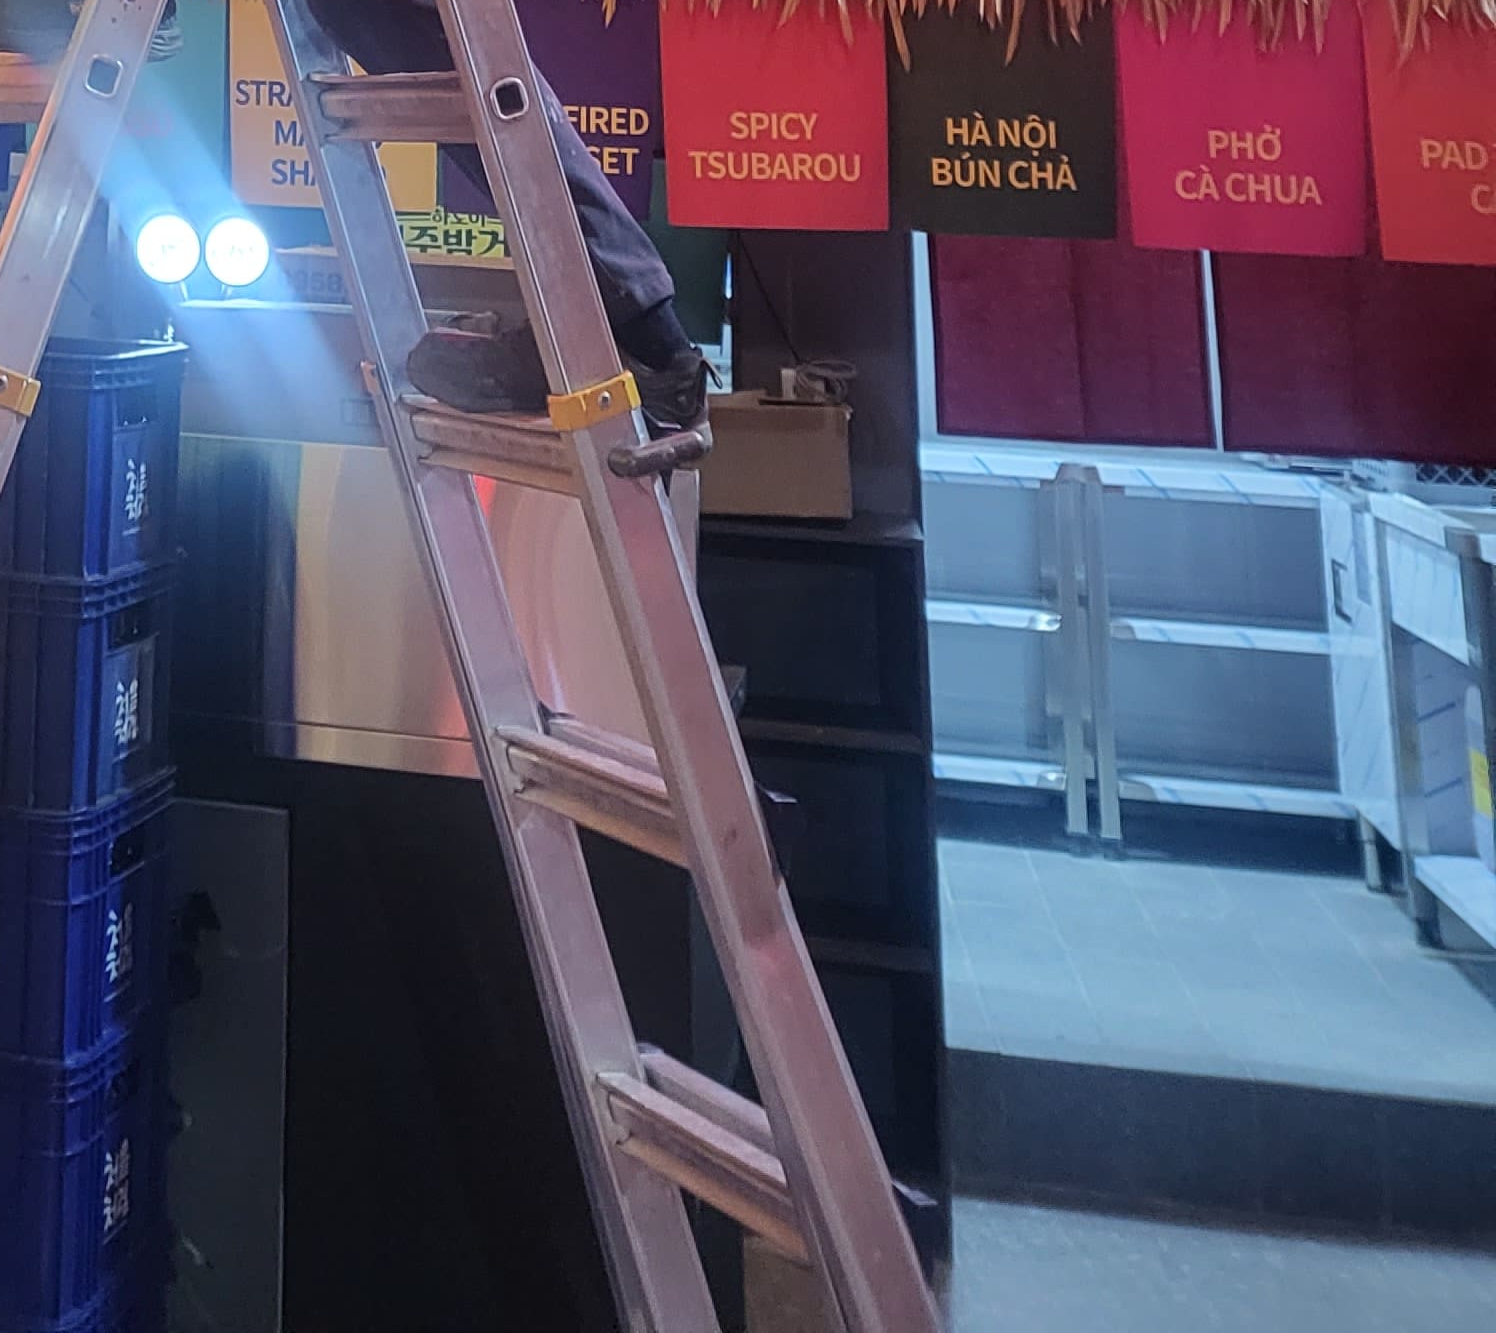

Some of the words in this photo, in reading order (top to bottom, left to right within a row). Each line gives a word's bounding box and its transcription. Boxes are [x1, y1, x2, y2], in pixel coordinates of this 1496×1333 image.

[730, 111, 817, 141] SPICY
[946, 112, 992, 147] HÀ
[998, 115, 1057, 157] NỘI
[689, 150, 861, 182] TSUBAROU
[931, 152, 1001, 188] BÚN
[1009, 155, 1078, 191] CHẢ
[1420, 138, 1489, 171] PAD
[1175, 165, 1220, 201] CÀ
[1225, 172, 1322, 206] CHUA
